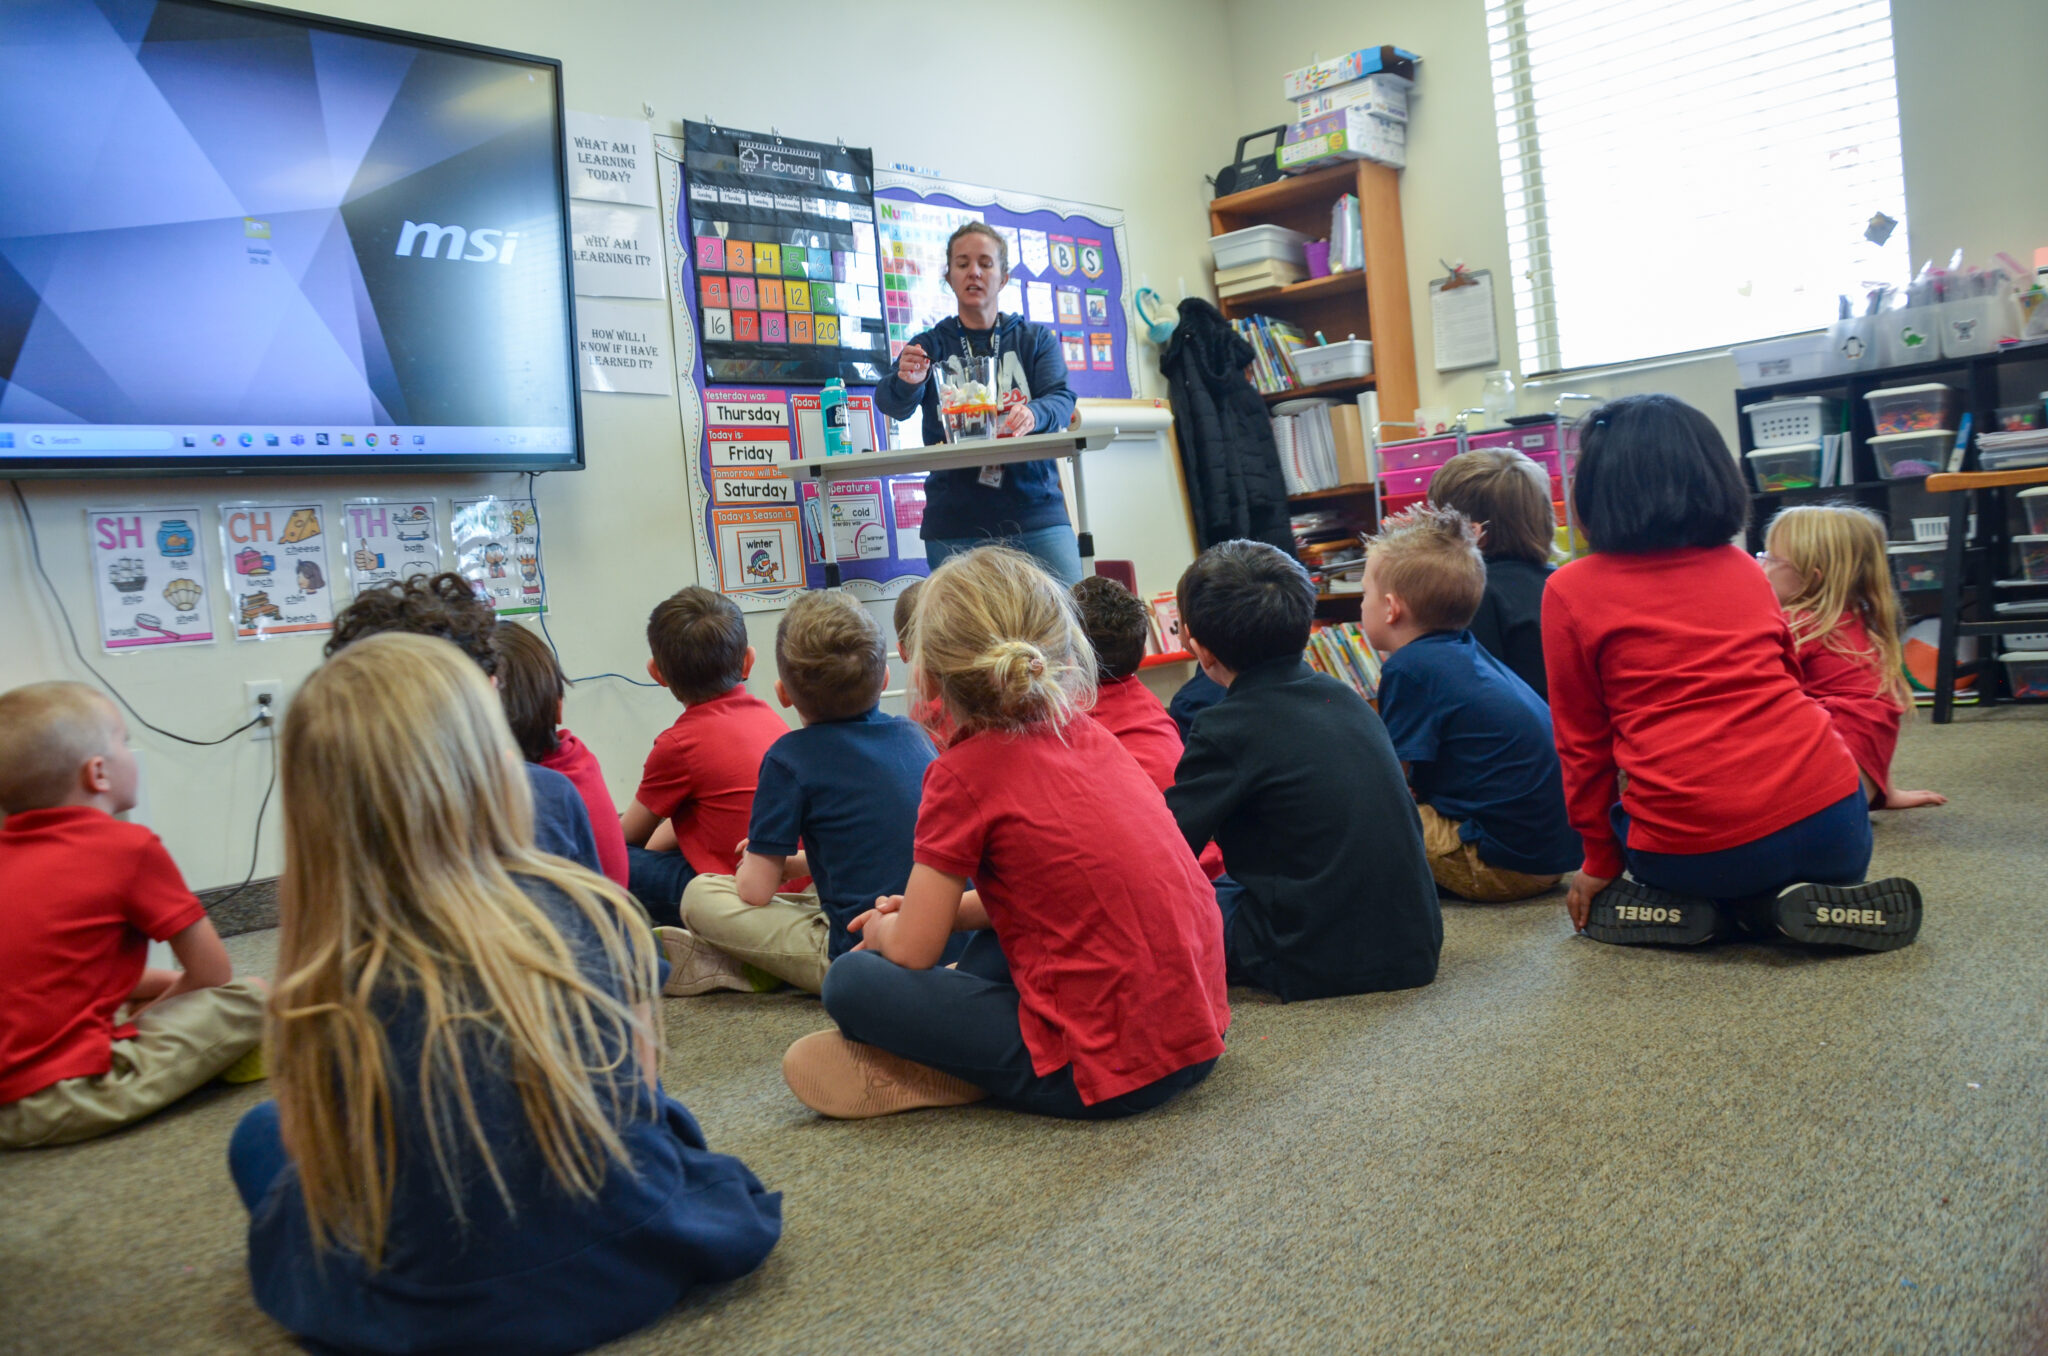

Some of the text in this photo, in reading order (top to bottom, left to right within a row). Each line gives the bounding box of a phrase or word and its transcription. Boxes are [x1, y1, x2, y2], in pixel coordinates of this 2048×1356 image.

[574, 136, 637, 154] WHAT AM I
[577, 152, 636, 169] LEARNING
[763, 153, 816, 181] February
[586, 168, 631, 183] TODAY?
[395, 220, 520, 265] msi
[584, 235, 639, 250] WHY AM I
[573, 250, 651, 267] LEARNING IT?
[705, 244, 824, 273] 2 3 4 5 6
[709, 284, 830, 308] 9 10 11 12 13
[592, 328, 646, 342] HOW WILL I
[711, 316, 837, 341] 16 17 18 19 20
[580, 341, 659, 357] KNOW IF I HAVE
[589, 355, 653, 369] LEARNED IT?
[705, 391, 747, 402] Yesterday
[793, 397, 821, 409] Today'
[716, 405, 780, 424] Thursday
[50, 435, 82, 446] Search
[708, 430, 744, 441] Today is:
[728, 445, 773, 463] Friday
[713, 469, 755, 478] Tomorrow
[758, 468, 770, 477] will
[724, 482, 787, 500] Saturday
[813, 483, 873, 496] Teperature:
[718, 510, 794, 522] Today's Season is:
[852, 508, 870, 517] cold
[229, 511, 273, 543] CH
[348, 507, 388, 538] TH
[96, 516, 144, 550] SH
[285, 545, 321, 554] cheese
[404, 544, 424, 552] bath
[746, 539, 773, 549] winter
[247, 579, 273, 587] lunch
[285, 595, 306, 603] chin
[286, 614, 317, 623] bench
[1615, 905, 1681, 923] SOREL
[1816, 906, 1886, 925] SOREL
